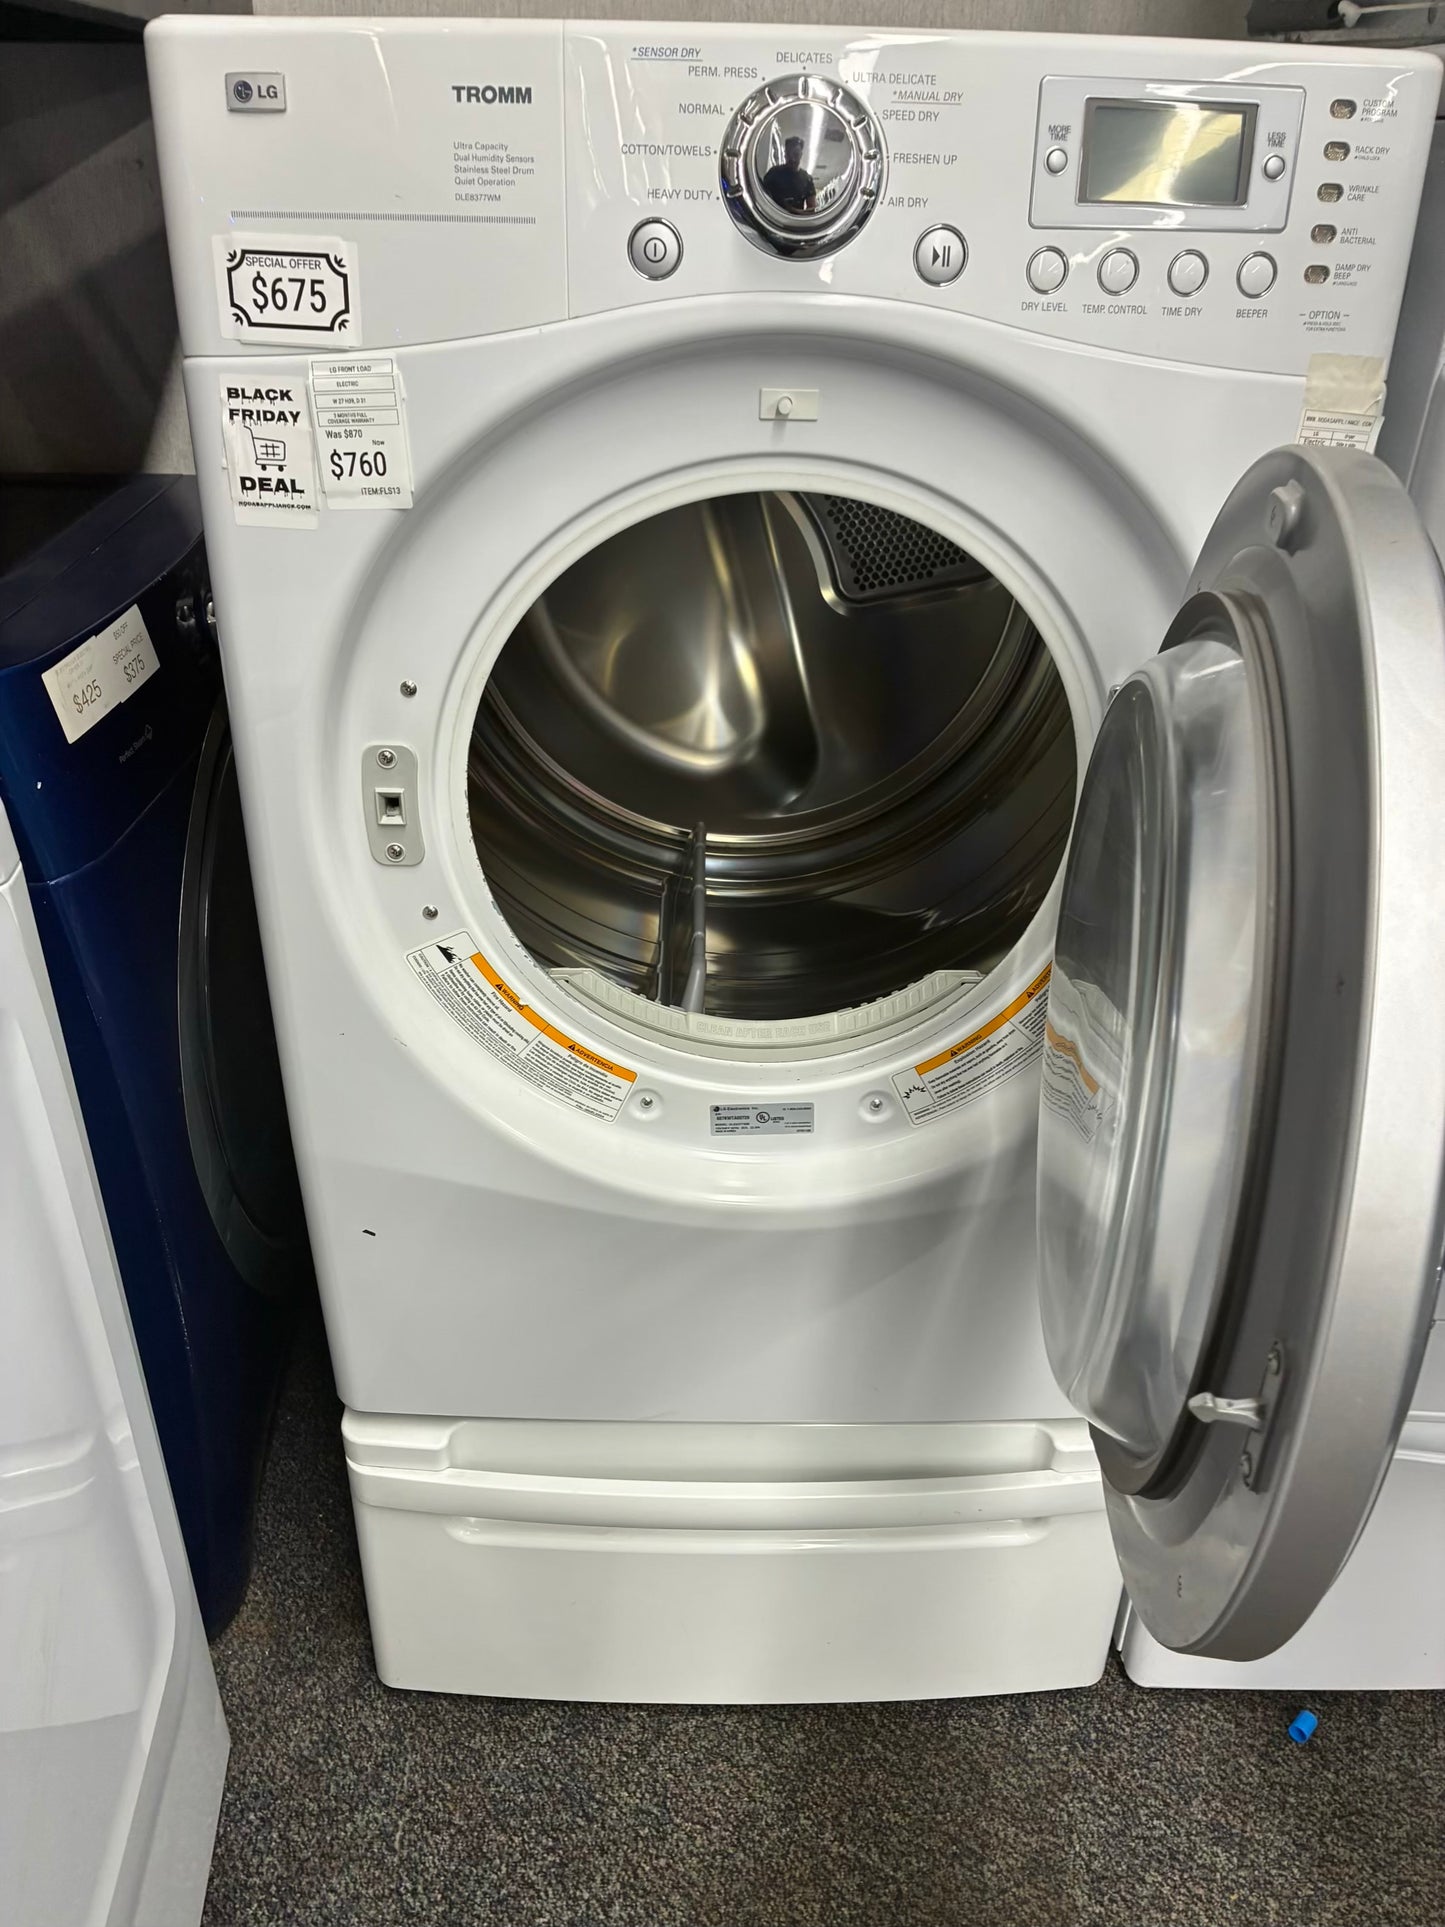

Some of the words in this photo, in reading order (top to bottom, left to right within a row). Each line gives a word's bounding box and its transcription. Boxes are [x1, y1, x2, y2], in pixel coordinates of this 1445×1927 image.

[680, 47, 701, 58] DRY
[776, 52, 833, 64] DELICATES
[688, 65, 721, 78] PERM.
[723, 66, 758, 79] PRESS
[852, 72, 886, 84] ULTRA
[888, 72, 937, 86] DELICATE
[258, 84, 278, 99] LG
[452, 85, 532, 104] TROMM
[943, 91, 964, 102] DRY
[1363, 99, 1395, 108] CUSTOM
[678, 103, 725, 116] NORMAL
[1362, 108, 1398, 117] PROGRAM
[882, 109, 916, 121] SPEED
[918, 110, 940, 122] DRY
[1048, 125, 1072, 134] MORE
[1050, 133, 1069, 141] TIME
[453, 141, 473, 150] Ultra
[474, 142, 509, 152] Capacity
[621, 144, 712, 157] COTTON/TOWELS
[1355, 146, 1374, 154] RACK
[1375, 146, 1391, 155] DRY
[454, 153, 470, 162] Dual
[472, 153, 504, 164] Humidity
[506, 154, 535, 163] Sensors
[893, 152, 940, 164] FRESHEN
[942, 154, 958, 166] UP
[454, 164, 489, 174] Stainless
[491, 165, 511, 175] Steel
[512, 166, 535, 175] Drum
[454, 176, 475, 186] Quiet
[477, 176, 516, 187] Operation
[648, 188, 682, 201] HEAVY
[684, 189, 713, 202] DUTY
[1349, 185, 1380, 194] WRINKLE
[888, 196, 904, 208] AIR
[906, 197, 929, 209] DRY
[1347, 193, 1366, 201] CARE
[1341, 228, 1358, 236] ANTI
[1340, 236, 1376, 245] BACTERIAL
[246, 256, 287, 269] SPECIAL
[289, 258, 322, 270] OFFER
[1336, 264, 1356, 272] DAMP
[1357, 264, 1372, 272] DRY
[1334, 272, 1351, 280] BEEP
[252, 270, 327, 314] $675
[1021, 302, 1041, 312] DRY
[1042, 302, 1068, 312] LEVEL
[1082, 304, 1106, 314] TEMP.
[1108, 304, 1148, 315] CONTROL
[1162, 307, 1183, 316] TIME
[1184, 307, 1203, 317] DRY
[1236, 309, 1268, 319] BEEPER
[329, 366, 337, 374] LG
[226, 387, 294, 404] BLACK
[228, 408, 301, 424] FRIDAY
[325, 430, 342, 439] Was
[344, 428, 363, 439] $870
[330, 449, 387, 481] $760
[240, 476, 305, 497] DEAL
[361, 487, 401, 496] ITEM:FLS13
[112, 648, 132, 665] SPECIAL
[130, 632, 145, 650] PRICE
[123, 654, 146, 684] $375
[72, 679, 103, 715] $425
[502, 988, 524, 1011] WARNING
[696, 1022, 733, 1037] CLEAN
[736, 1027, 773, 1039] AFTER
[808, 1021, 831, 1034] USE
[957, 1034, 982, 1053] WARNING
[576, 1048, 614, 1071] ADVERTENCIA
